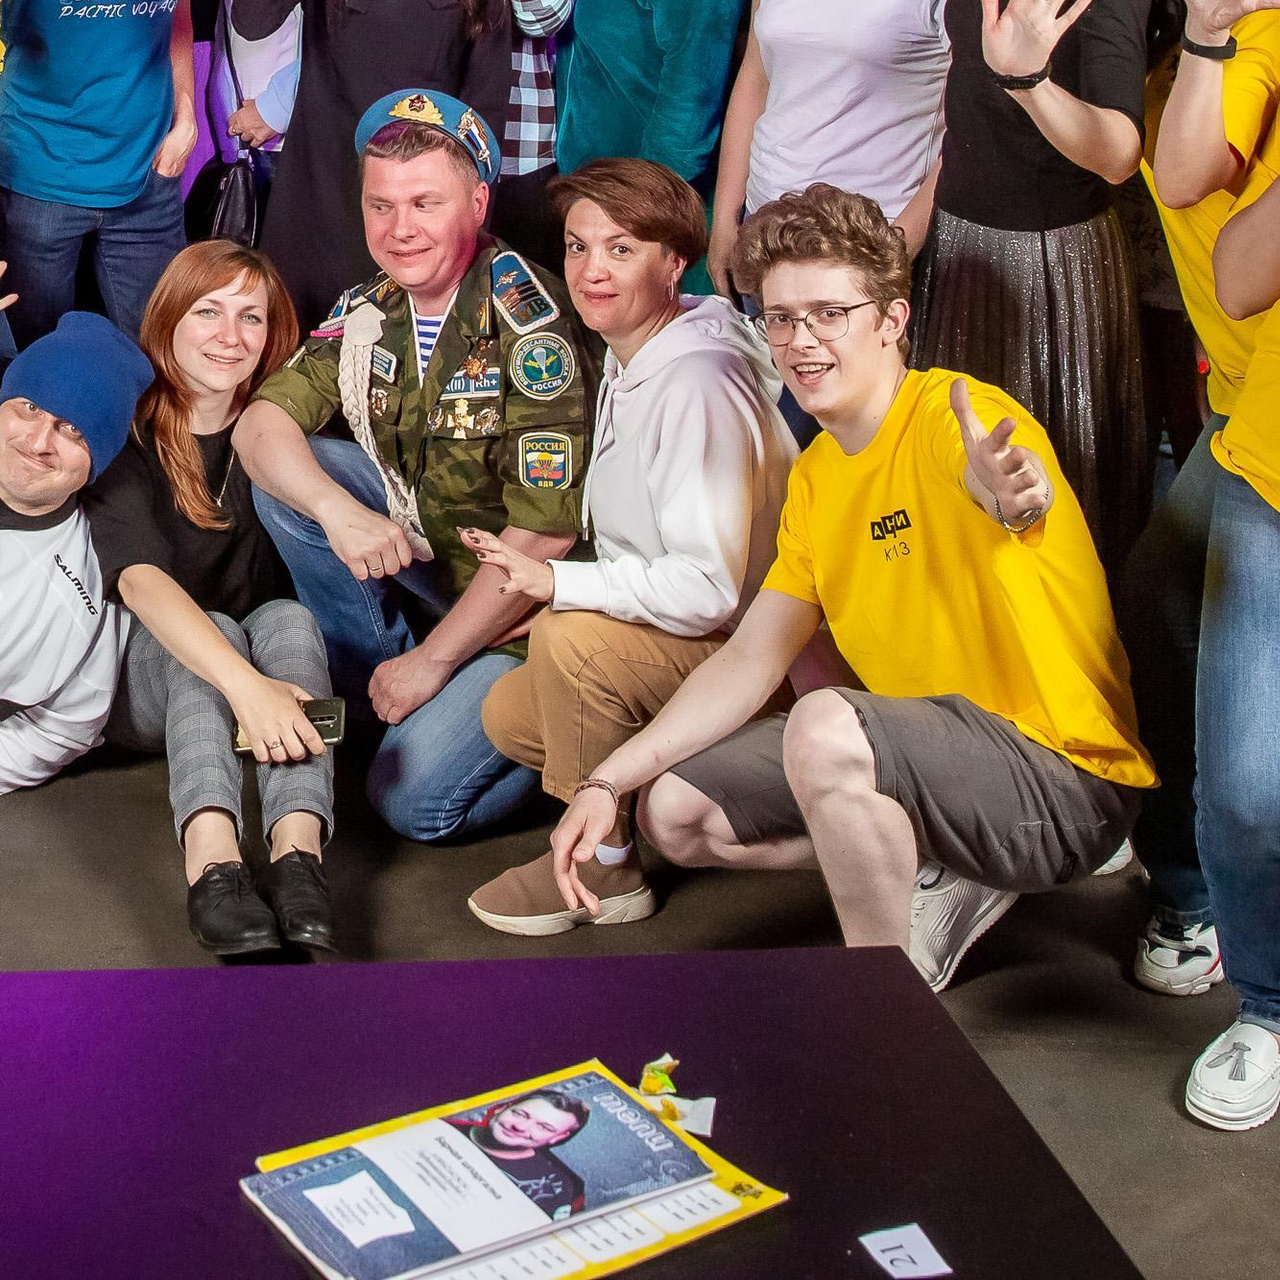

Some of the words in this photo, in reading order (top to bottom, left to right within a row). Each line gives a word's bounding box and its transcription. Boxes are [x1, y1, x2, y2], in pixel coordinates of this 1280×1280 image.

[532, 378, 563, 392] РОССИЯ
[525, 441, 566, 451] РОССИЯ
[592, 1090, 675, 1153] menu
